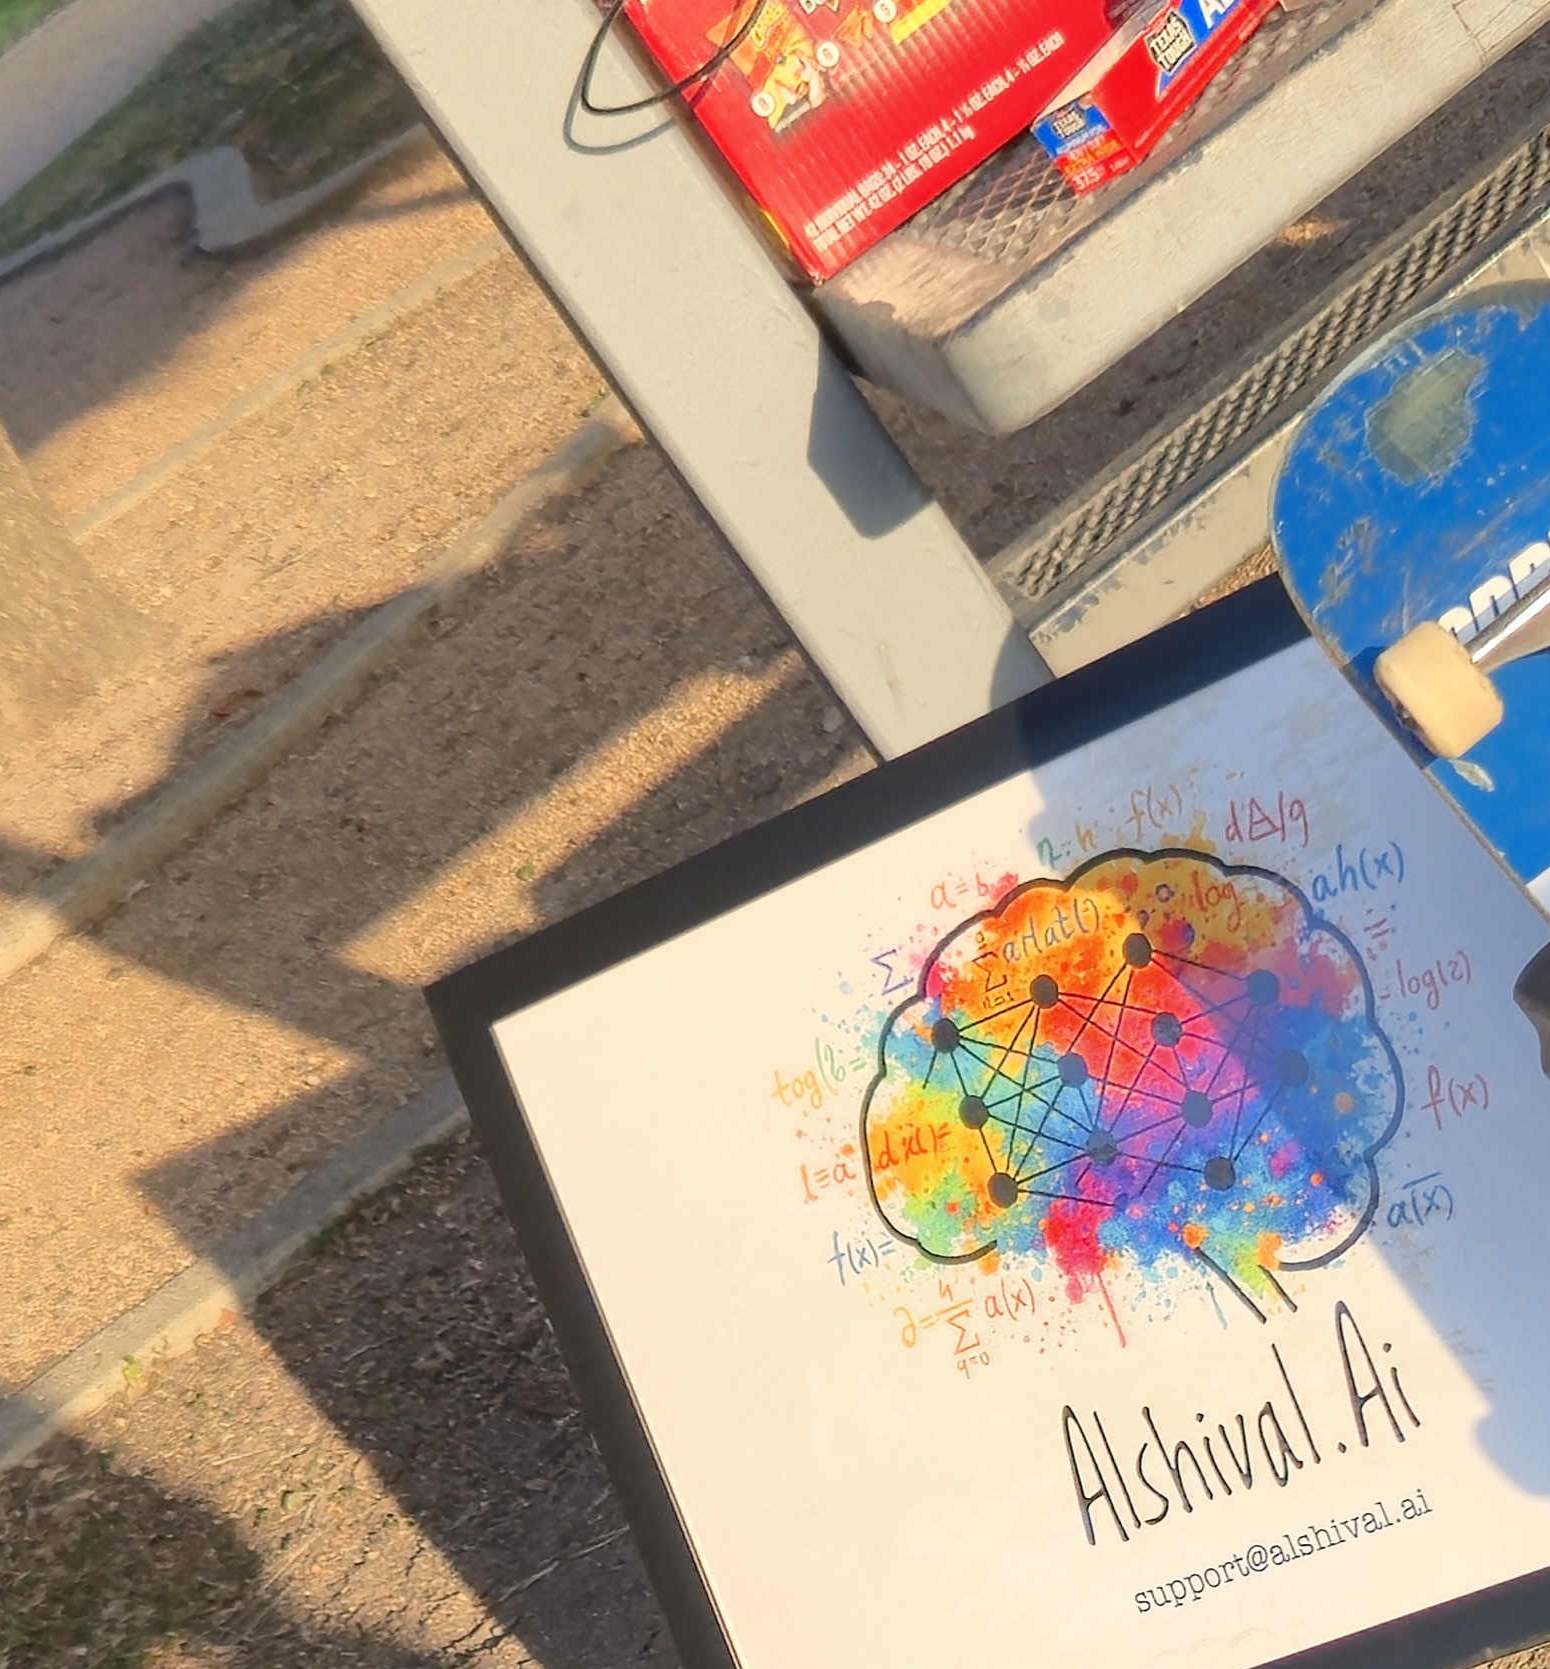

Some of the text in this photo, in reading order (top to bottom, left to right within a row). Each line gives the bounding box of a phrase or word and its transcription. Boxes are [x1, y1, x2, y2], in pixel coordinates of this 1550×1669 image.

[1150, 15, 1184, 53] TEXAS
[1157, 29, 1193, 70] TOUGH
[1060, 1300, 1421, 1546] Alshival.Ai
[1134, 1488, 1434, 1614] support@alshival.ai
